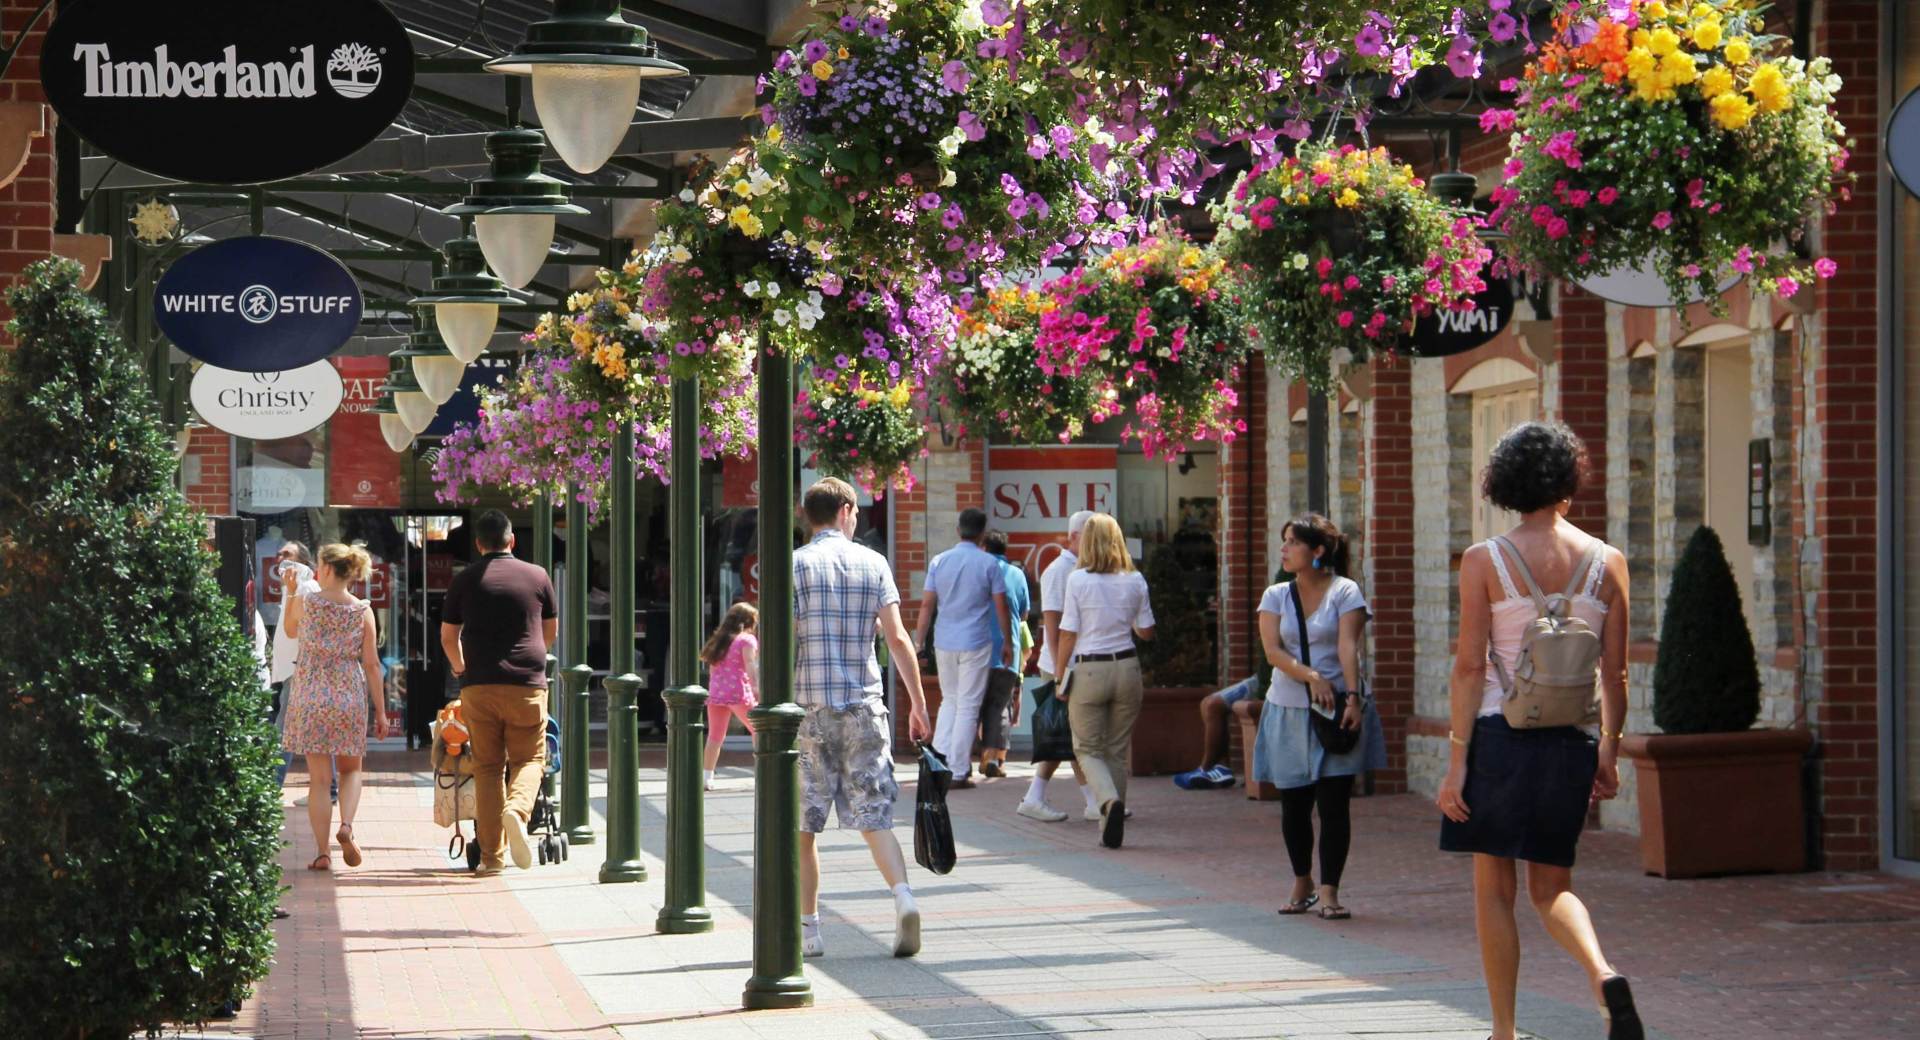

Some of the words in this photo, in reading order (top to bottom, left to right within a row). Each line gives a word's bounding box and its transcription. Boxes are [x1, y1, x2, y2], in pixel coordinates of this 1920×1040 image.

[73, 43, 317, 98] Timberland
[163, 295, 235, 313] WHITE
[280, 295, 352, 314] STUFF
[218, 387, 316, 412] Christy
[993, 482, 1112, 520] SALE
